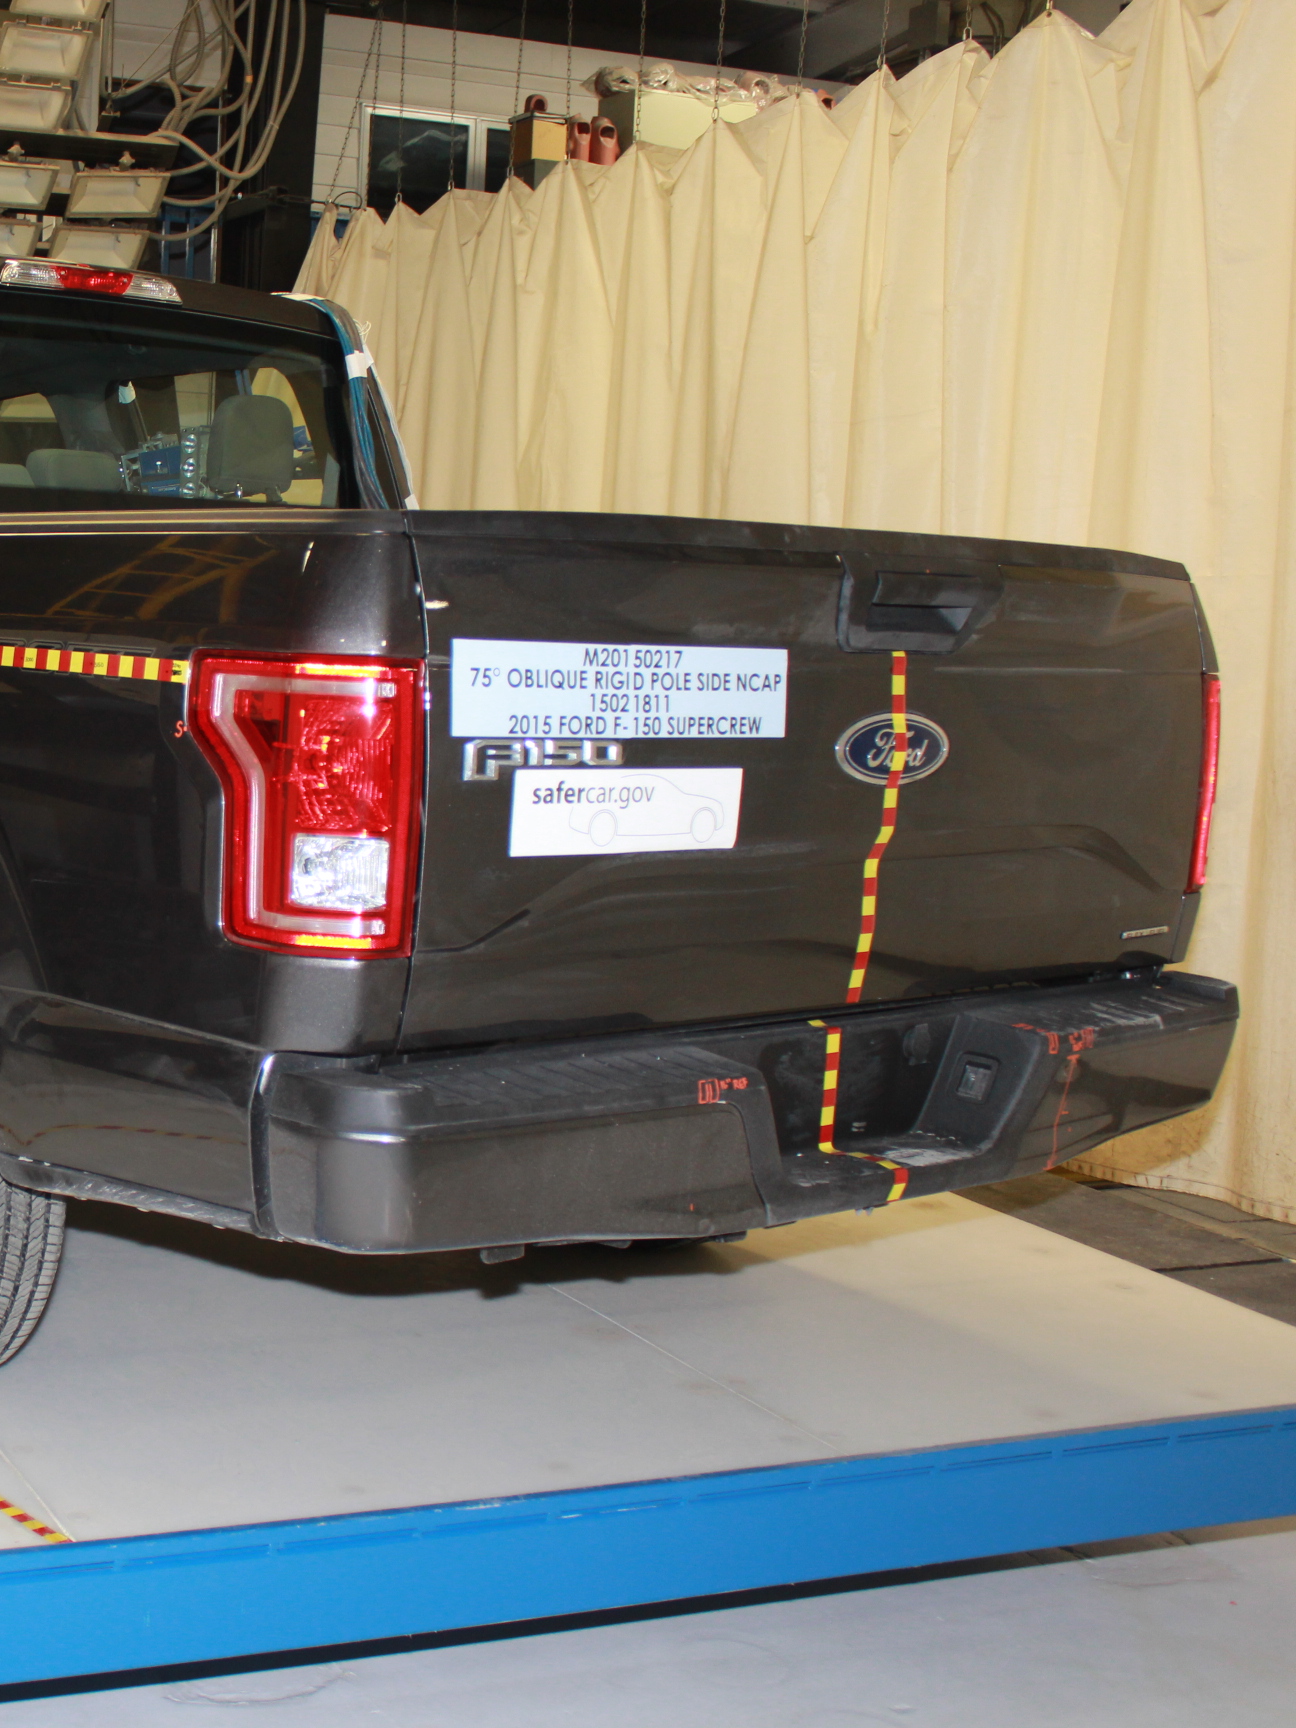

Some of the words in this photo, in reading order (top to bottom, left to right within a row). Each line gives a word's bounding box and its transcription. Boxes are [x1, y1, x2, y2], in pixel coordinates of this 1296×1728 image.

[583, 648, 683, 668] M20150217
[507, 667, 588, 690] OBLIQUE
[595, 670, 644, 691] RIGID
[651, 671, 692, 692] POLE
[697, 672, 732, 692] SIDE
[736, 673, 782, 692] NCAP
[589, 693, 670, 713] 15021811
[508, 714, 552, 735] 2015
[559, 715, 607, 735] FORD
[667, 715, 762, 736] SUPERCREW
[532, 780, 655, 809] safercar.gov
